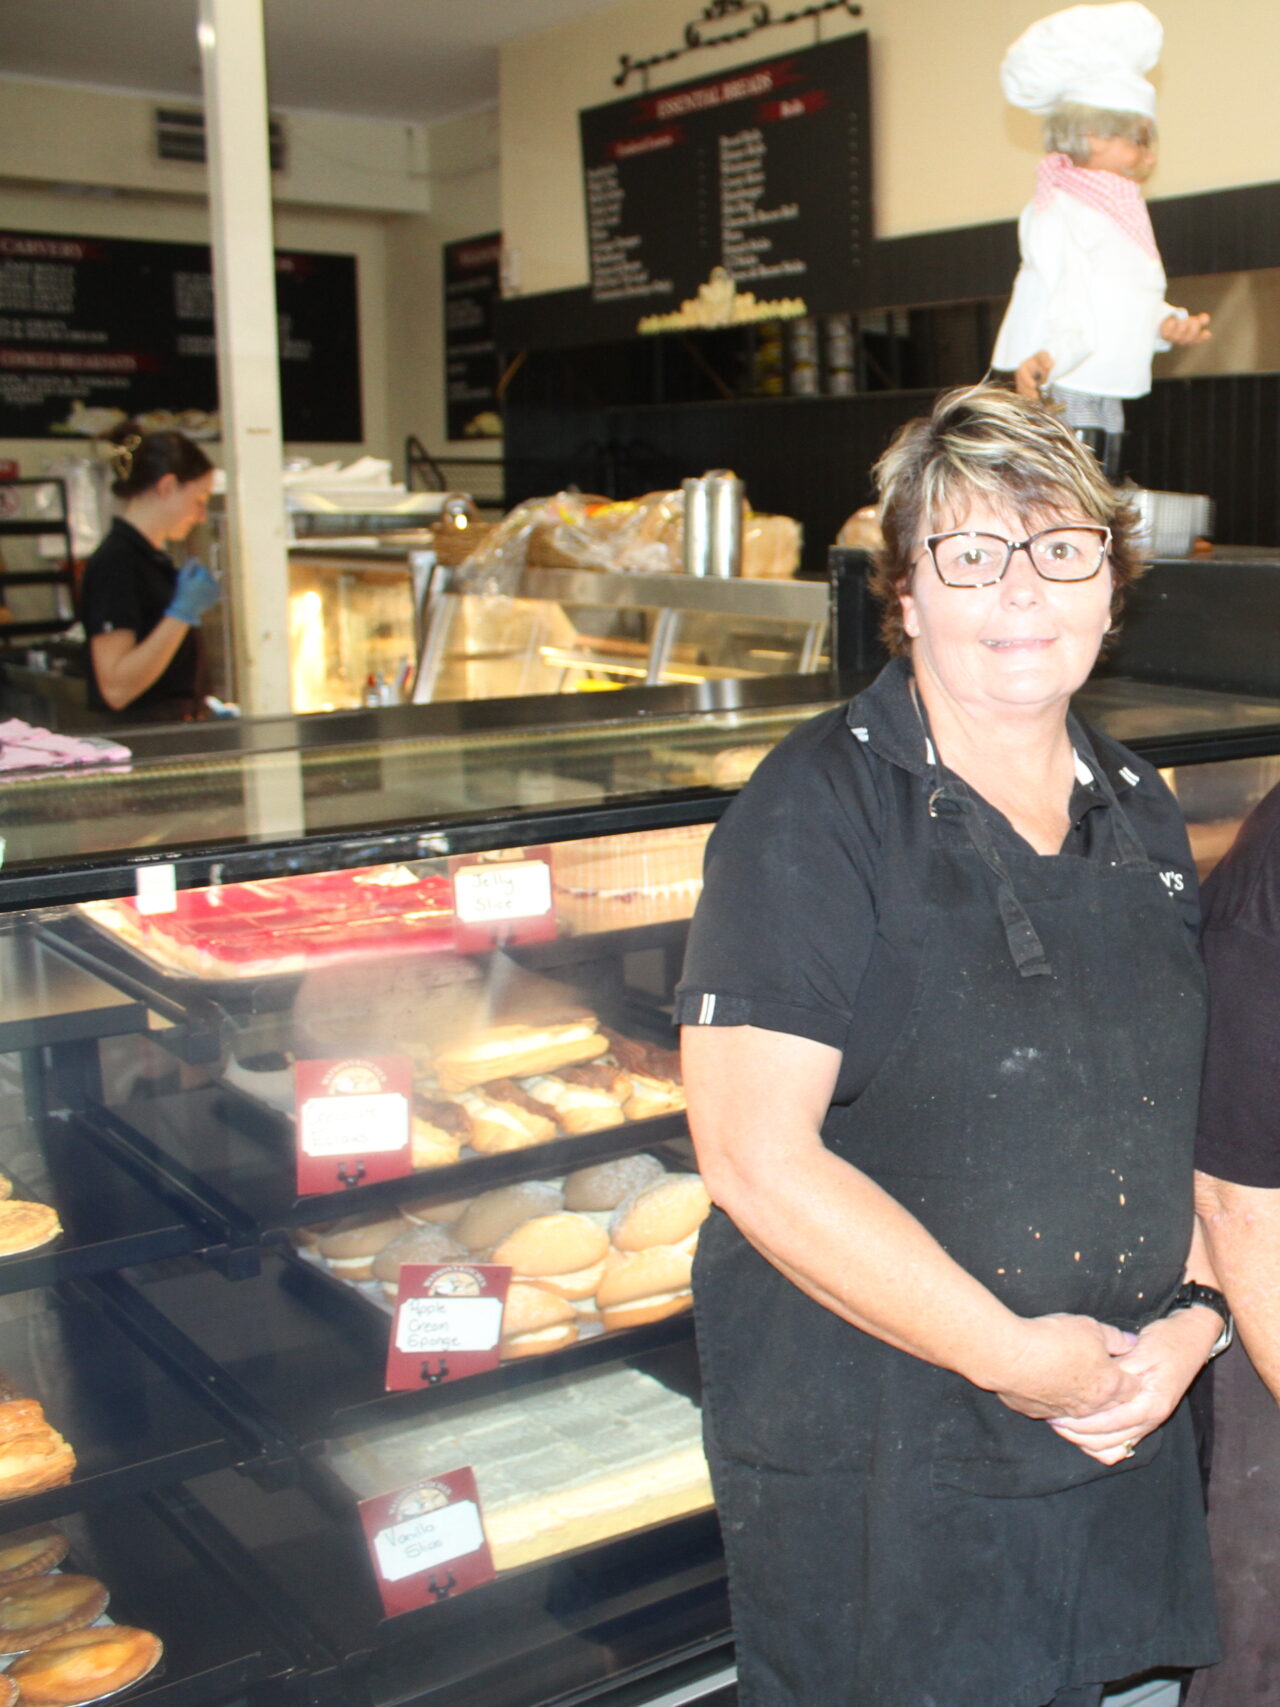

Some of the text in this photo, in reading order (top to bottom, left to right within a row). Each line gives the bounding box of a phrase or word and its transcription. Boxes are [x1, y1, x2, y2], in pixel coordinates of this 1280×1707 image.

[472, 871, 515, 896] Jelly
[408, 1296, 446, 1316] Apple
[407, 1318, 449, 1333] Cream
[407, 1334, 461, 1351] Sponge
[384, 1522, 435, 1547] Vanilla
